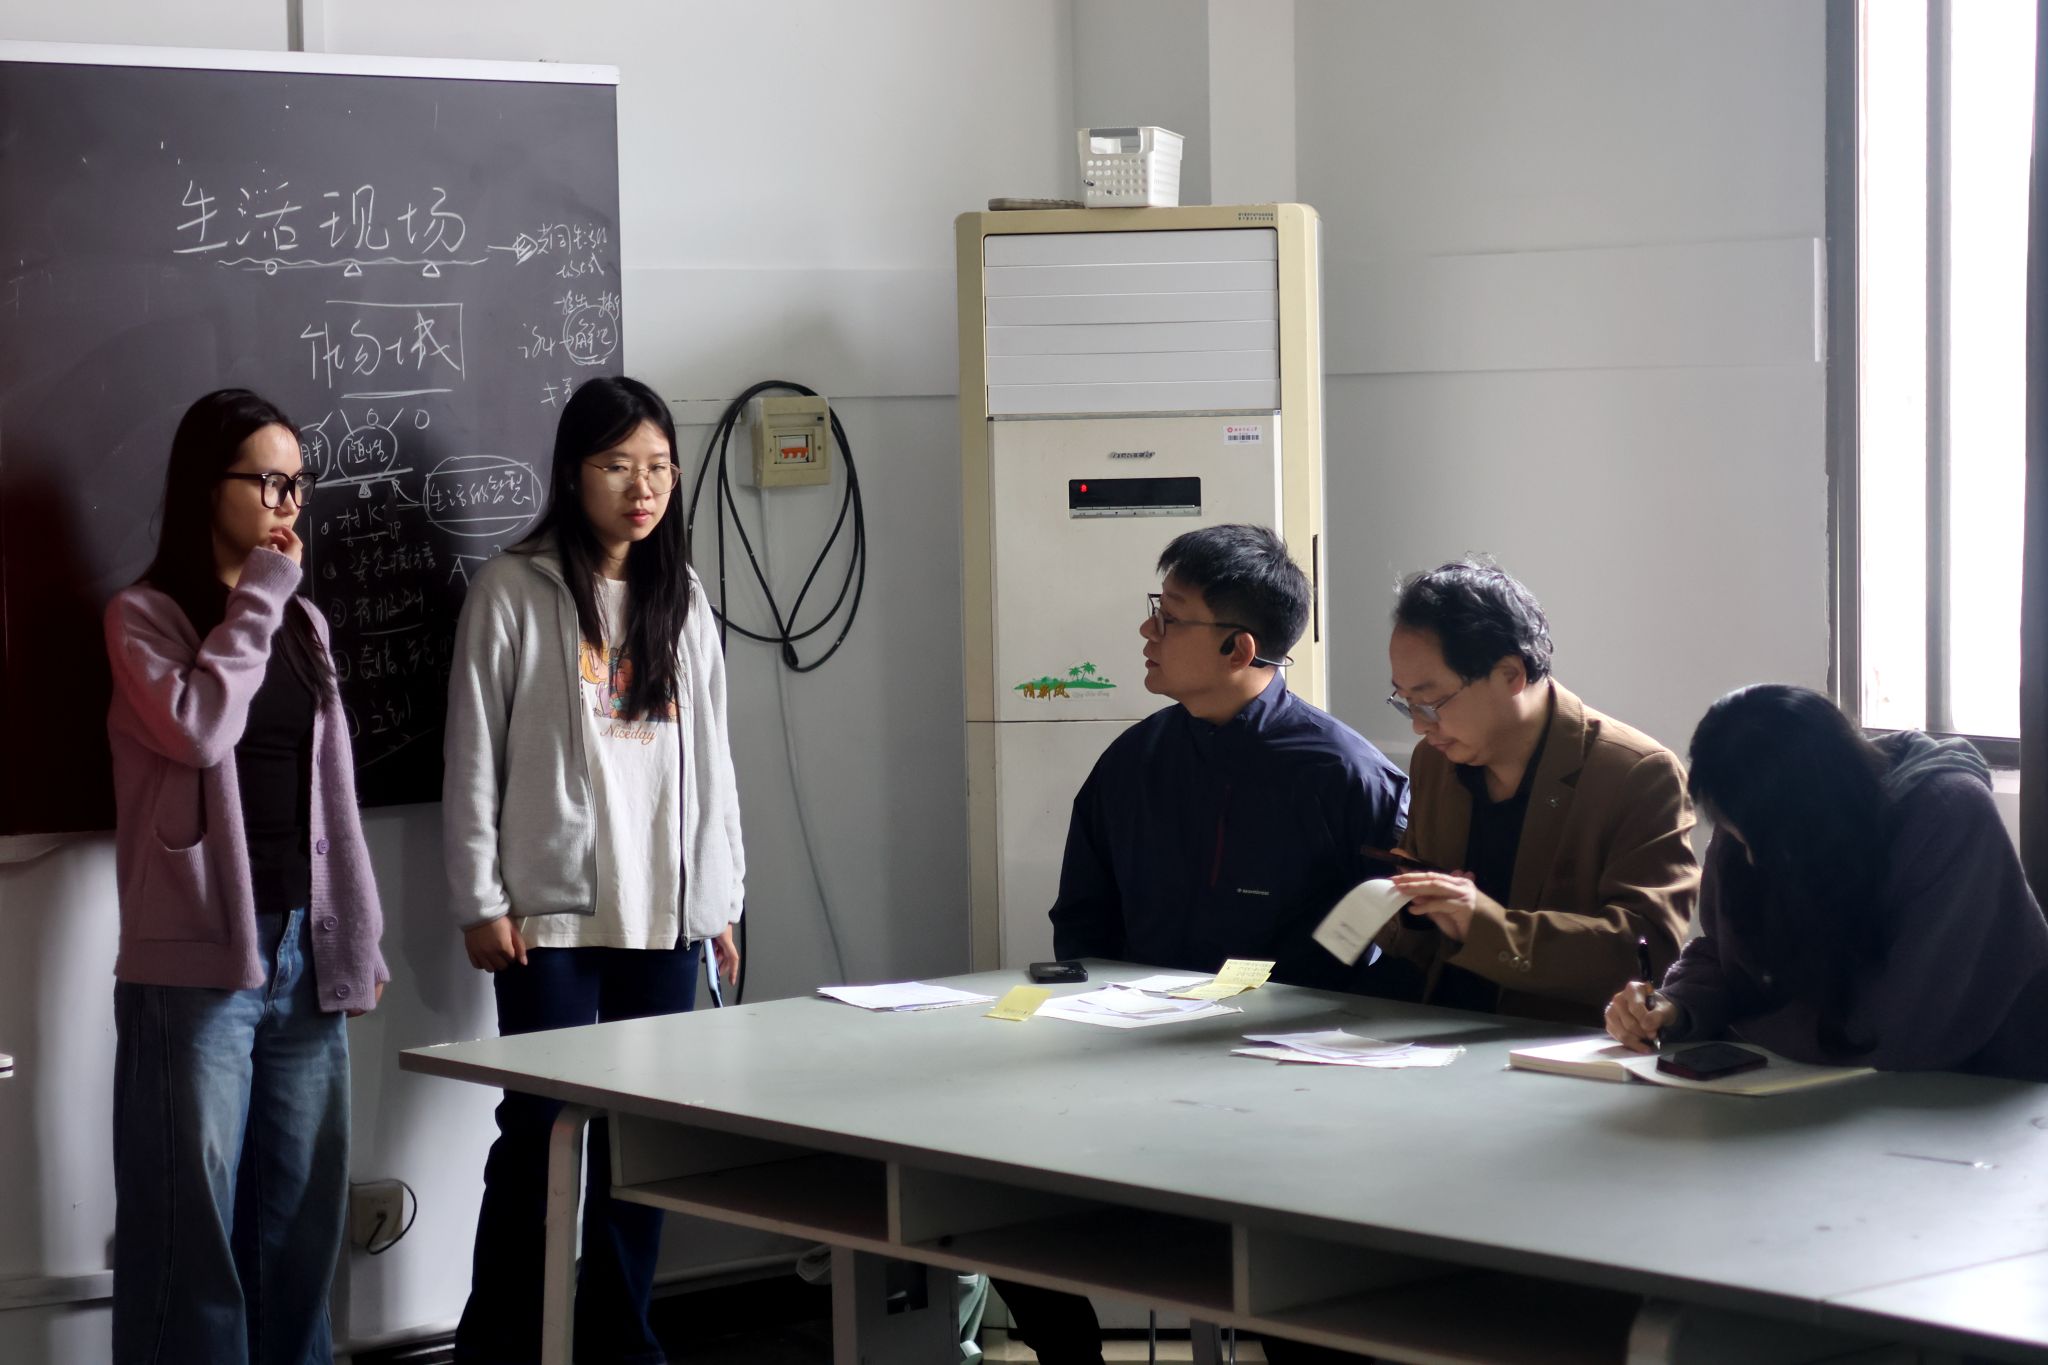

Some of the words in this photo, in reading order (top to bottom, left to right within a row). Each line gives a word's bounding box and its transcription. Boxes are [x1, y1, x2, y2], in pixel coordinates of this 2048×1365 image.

[173, 178, 466, 254] 生活现场
[599, 724, 656, 746] Niceday
